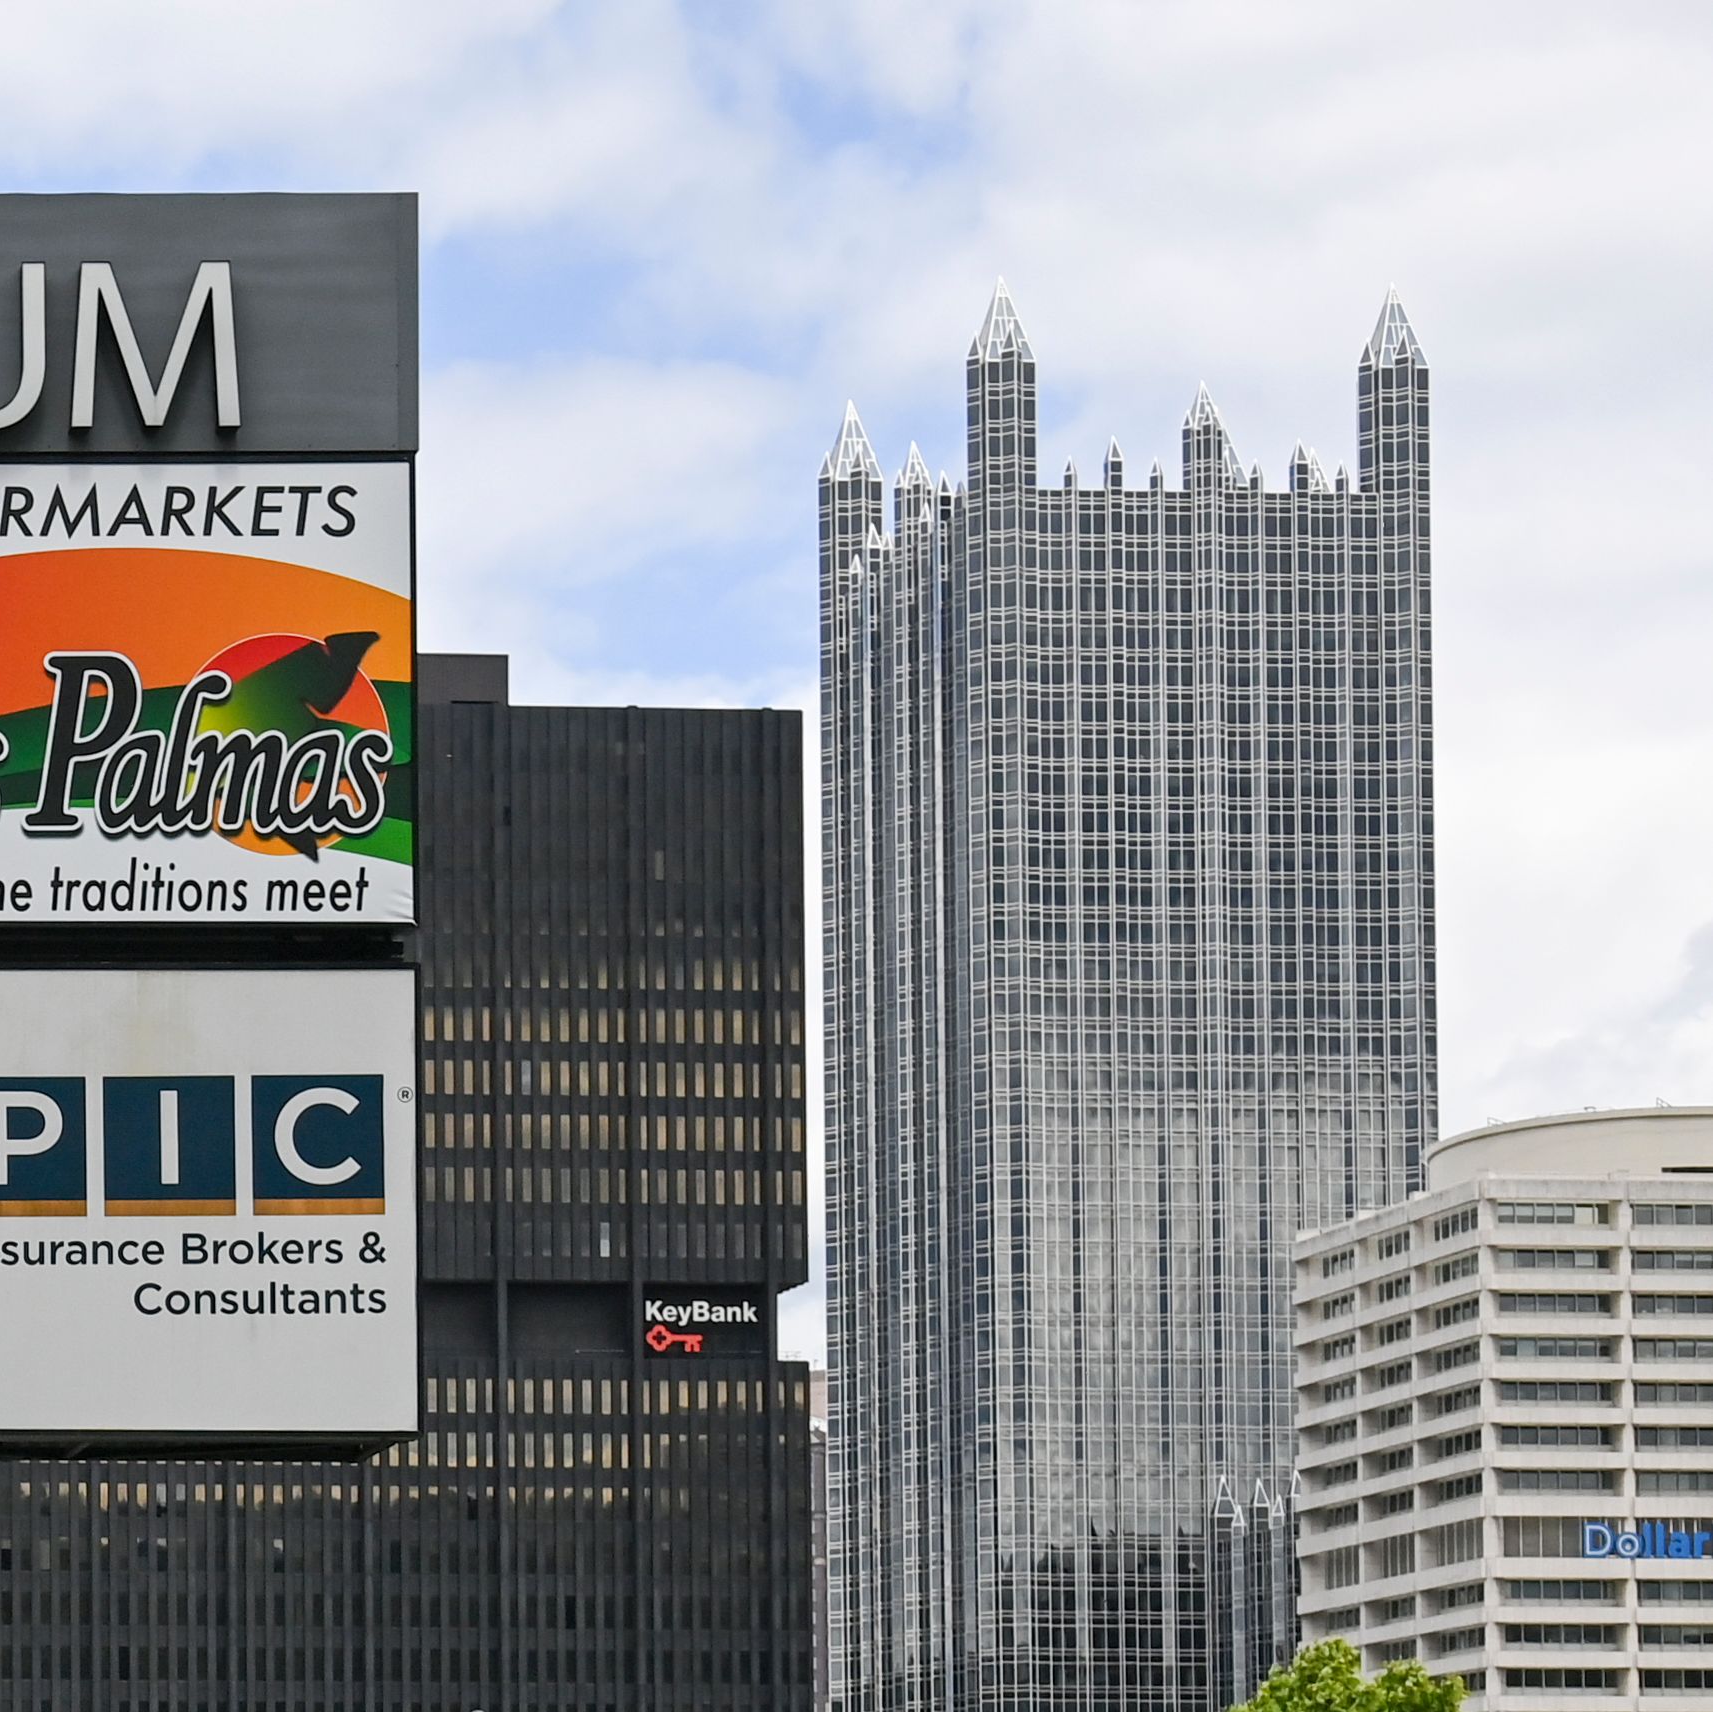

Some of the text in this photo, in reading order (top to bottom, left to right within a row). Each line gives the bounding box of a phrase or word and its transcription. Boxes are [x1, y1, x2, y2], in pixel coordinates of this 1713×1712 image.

[23, 649, 391, 839] Palmas
[48, 860, 244, 914] traditions
[264, 872, 370, 914] meet
[182, 1232, 347, 1268] Brokers
[358, 1232, 386, 1268] &
[133, 1280, 386, 1316] Consultants
[645, 1300, 758, 1326] KeyBank
[1583, 1522, 1711, 1558] Dollar
